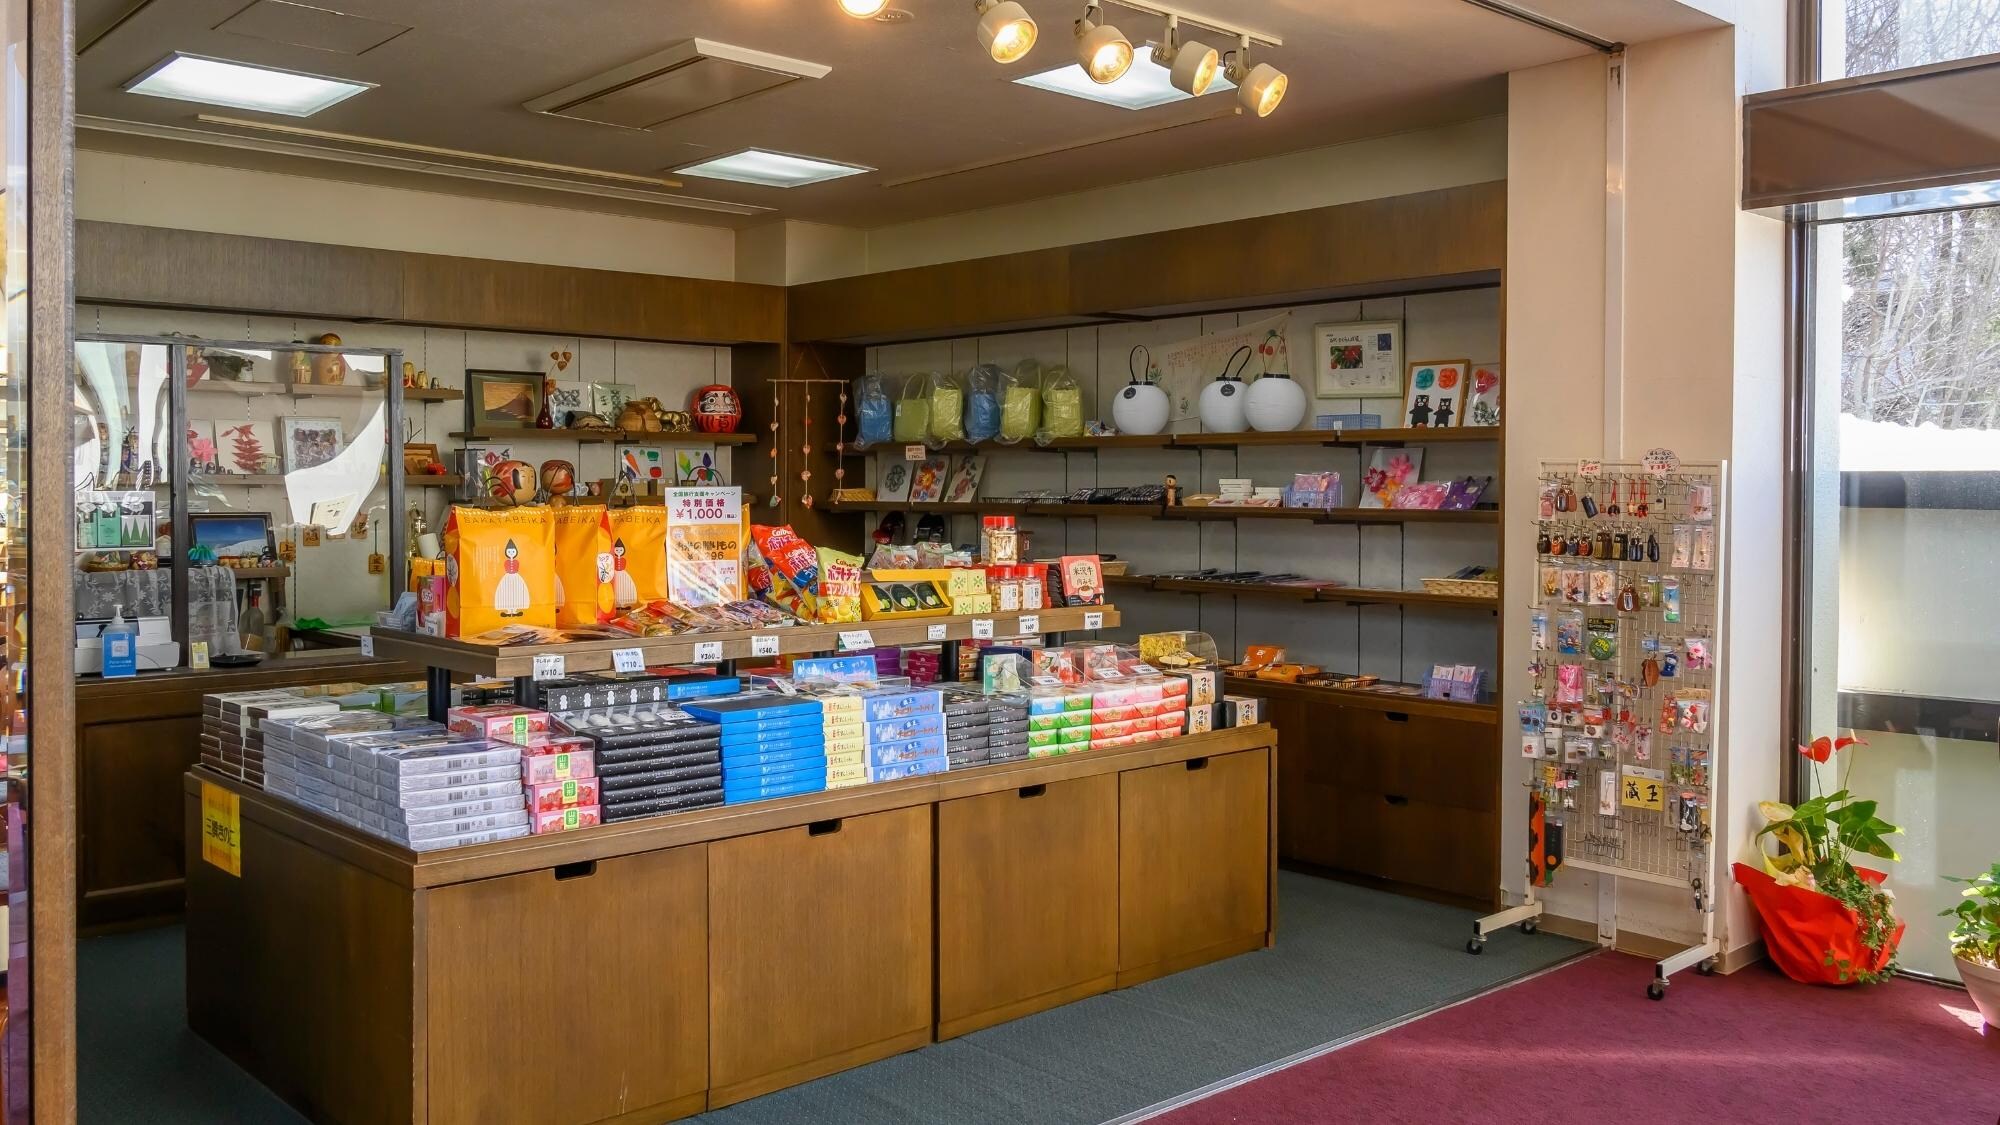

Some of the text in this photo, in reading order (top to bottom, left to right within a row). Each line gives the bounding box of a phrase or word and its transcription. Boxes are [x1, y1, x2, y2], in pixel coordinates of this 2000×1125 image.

[682, 498, 726, 508] 特別価格
[676, 508, 723, 520] ¥1,000
[463, 515, 547, 525] SAKATABEIKA
[1073, 565, 1093, 576] 米沢牛
[1625, 780, 1660, 802] 蔵王
